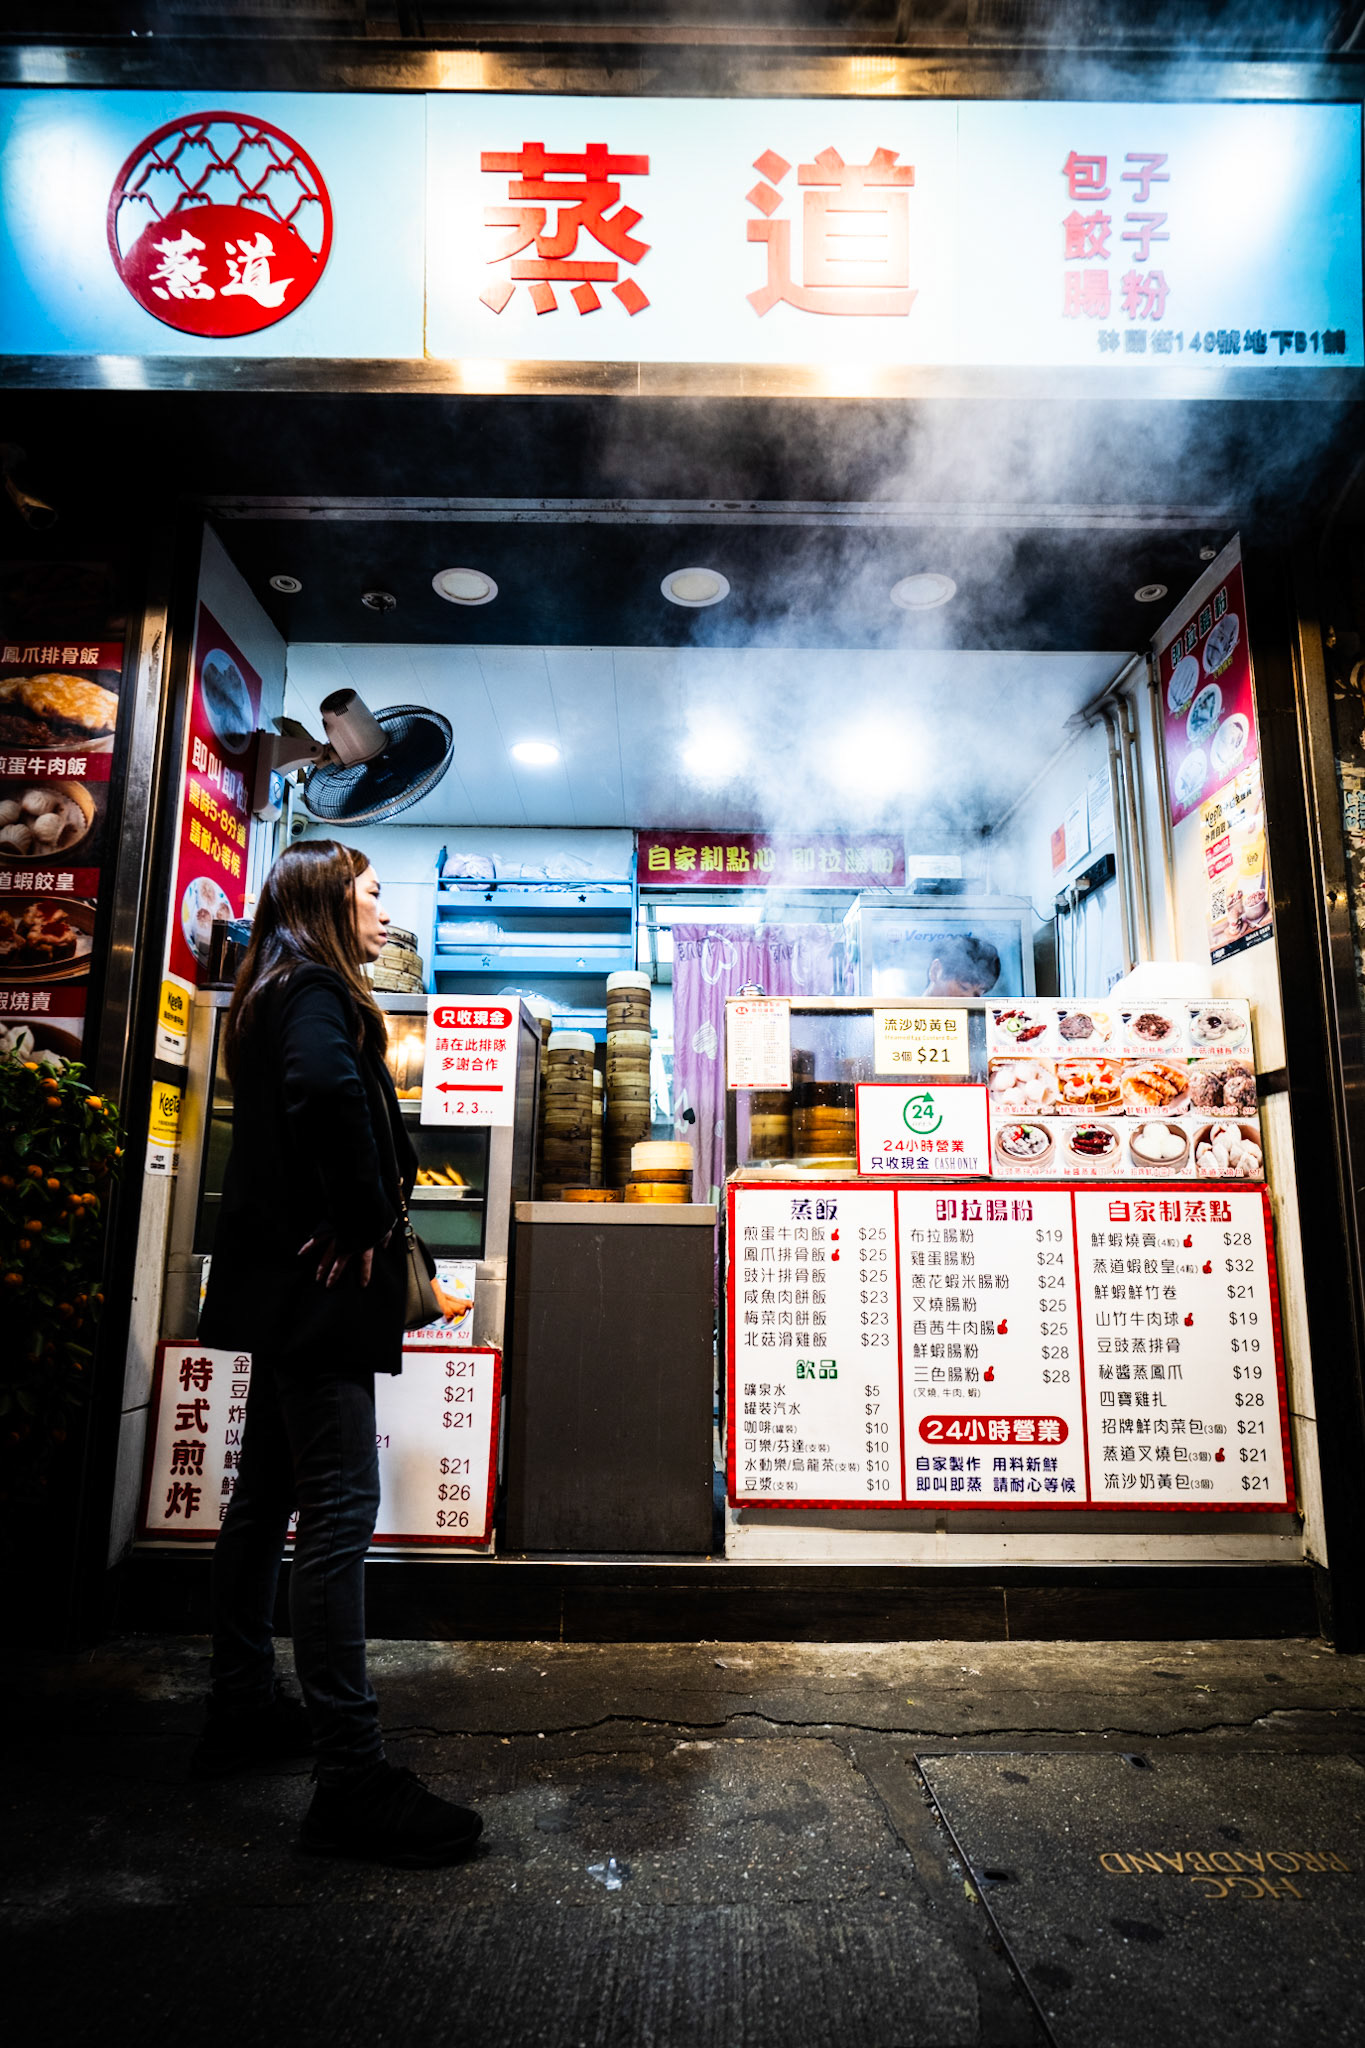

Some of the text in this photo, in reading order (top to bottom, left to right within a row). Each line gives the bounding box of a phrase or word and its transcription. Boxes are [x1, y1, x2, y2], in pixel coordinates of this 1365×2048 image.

[1062, 150, 1171, 202] 包子
[480, 142, 918, 318] 蒸道
[1062, 210, 1171, 262] 餃子
[149, 228, 295, 309] 蒸道
[2, 646, 100, 665] 鳳爪排骨飯
[441, 1010, 505, 1026] 只收現金
[884, 1018, 957, 1032] 流沙奶黃包
[436, 1038, 507, 1052] 請在此排隊
[917, 1046, 950, 1064] $21
[442, 1057, 498, 1071] 多謝合作
[912, 1105, 934, 1119] 24
[883, 1140, 965, 1152] 24小時營業
[871, 1156, 978, 1170] 只收現金 CASH ONLY
[791, 1199, 838, 1220] 蒸飯
[936, 1199, 1033, 1222] 即拉腸粉
[1109, 1200, 1232, 1222] 自家制蒸點
[744, 1226, 887, 1241] 煎蛋牛肉飯 $25
[911, 1229, 1063, 1243] 布拉腸粉 $19
[1223, 1232, 1252, 1246] $28
[744, 1247, 888, 1262] 鳳爪排骨飯 $25
[911, 1251, 1064, 1266] 雞蛋腸粉 $24
[1225, 1258, 1254, 1272] $32
[744, 1268, 888, 1283] 豉汁排骨飯 $25
[1038, 1275, 1066, 1289] $24
[744, 1289, 889, 1304] 咸魚肉餅飯 $23
[1094, 1284, 1255, 1300] 鮮蝦鮮竹卷 $21
[913, 1297, 1067, 1312] 叉燒腸粉 $25
[744, 1310, 889, 1326] 梅菜肉餅飯 $23
[1095, 1311, 1258, 1327] 山竹牛肉球 $19
[913, 1320, 1068, 1336] 香茜牛肉腸 $25
[744, 1332, 890, 1347] 北菇滑雞飯 $23
[1097, 1337, 1260, 1353] 豆豉蒸排骨 $19
[913, 1343, 1069, 1360] 鮮蝦腸粉 $28
[232, 1355, 251, 1374] 金
[445, 1361, 476, 1378] $21
[796, 1359, 838, 1379] 飲品
[1098, 1364, 1263, 1380] 秘醬蒸鳳爪 $19
[914, 1366, 1070, 1384] 三色腸粉 $28
[230, 1380, 249, 1399] 豆
[443, 1386, 475, 1404] $21
[744, 1383, 880, 1397] 礦泉水 $5
[1100, 1391, 1265, 1407] 四寶雞扎 $28
[744, 1402, 880, 1416] 罐裝汽水 $7
[442, 1411, 473, 1430] $21
[865, 1422, 889, 1435] $10
[1237, 1420, 1265, 1435] $21
[164, 1357, 214, 1519] 特式煎炸
[926, 1419, 1062, 1442] 24小時營業
[866, 1441, 889, 1454] $10
[1239, 1448, 1267, 1462] $21
[439, 1457, 471, 1476] $21
[866, 1460, 890, 1472] $10
[916, 1456, 1058, 1472] 自家製作 用料新鮮
[866, 1479, 890, 1491] $10
[916, 1476, 1076, 1493] 即叫即蒸 請耐心等候
[1241, 1475, 1270, 1491] $21
[438, 1483, 471, 1502] $26
[436, 1510, 469, 1529] $26
[1100, 1852, 1351, 1874] BROADBAND
[1191, 1877, 1303, 1898] HGC
